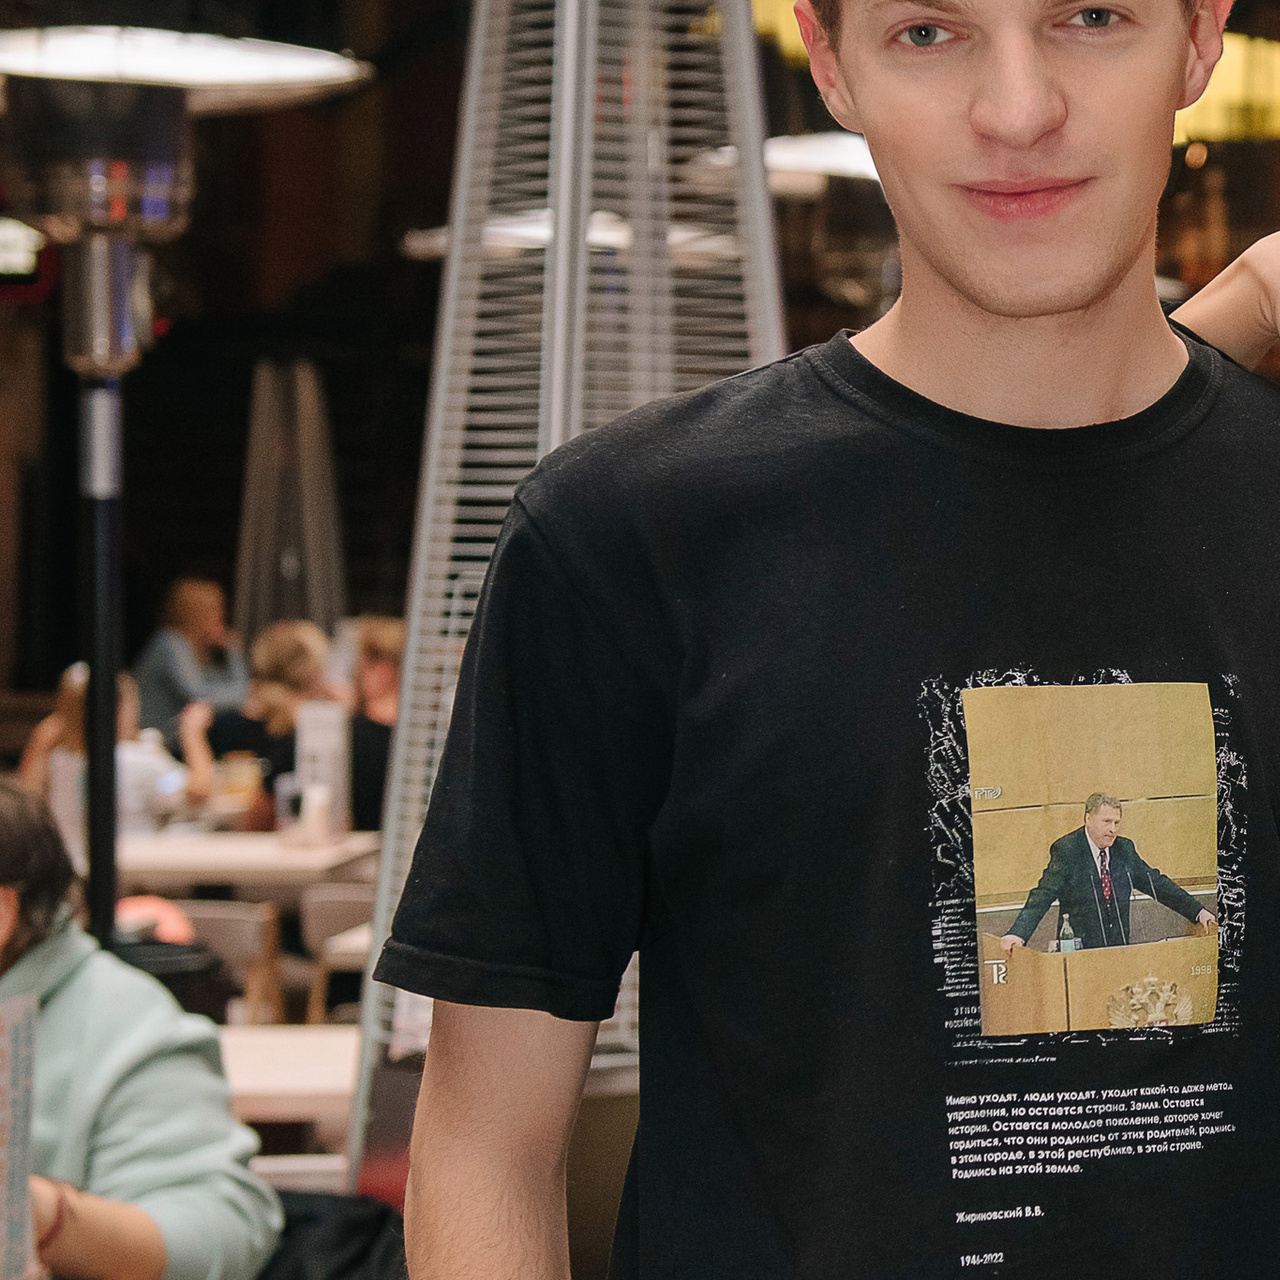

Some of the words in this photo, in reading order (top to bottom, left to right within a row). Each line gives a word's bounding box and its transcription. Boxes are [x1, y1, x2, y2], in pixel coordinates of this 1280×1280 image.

[1191, 965, 1212, 975] 1998
[945, 1095, 977, 1106] Имена
[978, 1092, 1021, 1106] уходят,
[1023, 1092, 1055, 1103] люди
[1056, 1090, 1099, 1103] уходят,
[1101, 1087, 1138, 1100] уходит
[1140, 1084, 1180, 1096] какой-то
[1181, 1082, 1205, 1094] даже
[1206, 1082, 1234, 1092] метод
[946, 1107, 1009, 1122] управления,
[1011, 1107, 1026, 1117] но
[1028, 1105, 1083, 1116] остается
[1162, 1098, 1205, 1109] Остается
[948, 1124, 990, 1136] история.
[992, 1121, 1049, 1132] Остается
[1051, 1119, 1103, 1131] молодое
[1105, 1115, 1162, 1127] поколение,
[1163, 1112, 1199, 1123] которое
[1200, 1110, 1224, 1121] хочет
[949, 1138, 1002, 1151] гордиться,
[1003, 1136, 1025, 1147] что
[1026, 1135, 1048, 1146] они
[1050, 1132, 1106, 1147] родились
[1107, 1132, 1119, 1142] от
[1121, 1129, 1145, 1141] этих
[1146, 1125, 1197, 1141] родителей,
[1199, 1123, 1237, 1137] родились
[950, 1155, 957, 1165] в
[958, 1153, 982, 1164] этом
[983, 1150, 1026, 1163] городе,
[1028, 1150, 1035, 1160] в
[1037, 1148, 1065, 1160] этой
[1067, 1144, 1136, 1160] республике,
[1137, 1144, 1144, 1154] в
[1145, 1142, 1169, 1154] этой
[1169, 1140, 1204, 1153] стране.
[952, 1166, 997, 1179] Родились
[999, 1165, 1013, 1176] на
[1015, 1162, 1043, 1174] этой
[1045, 1163, 1083, 1174] земле.
[955, 1206, 1023, 1224] Жириновский
[1024, 1205, 1045, 1218] В.В.
